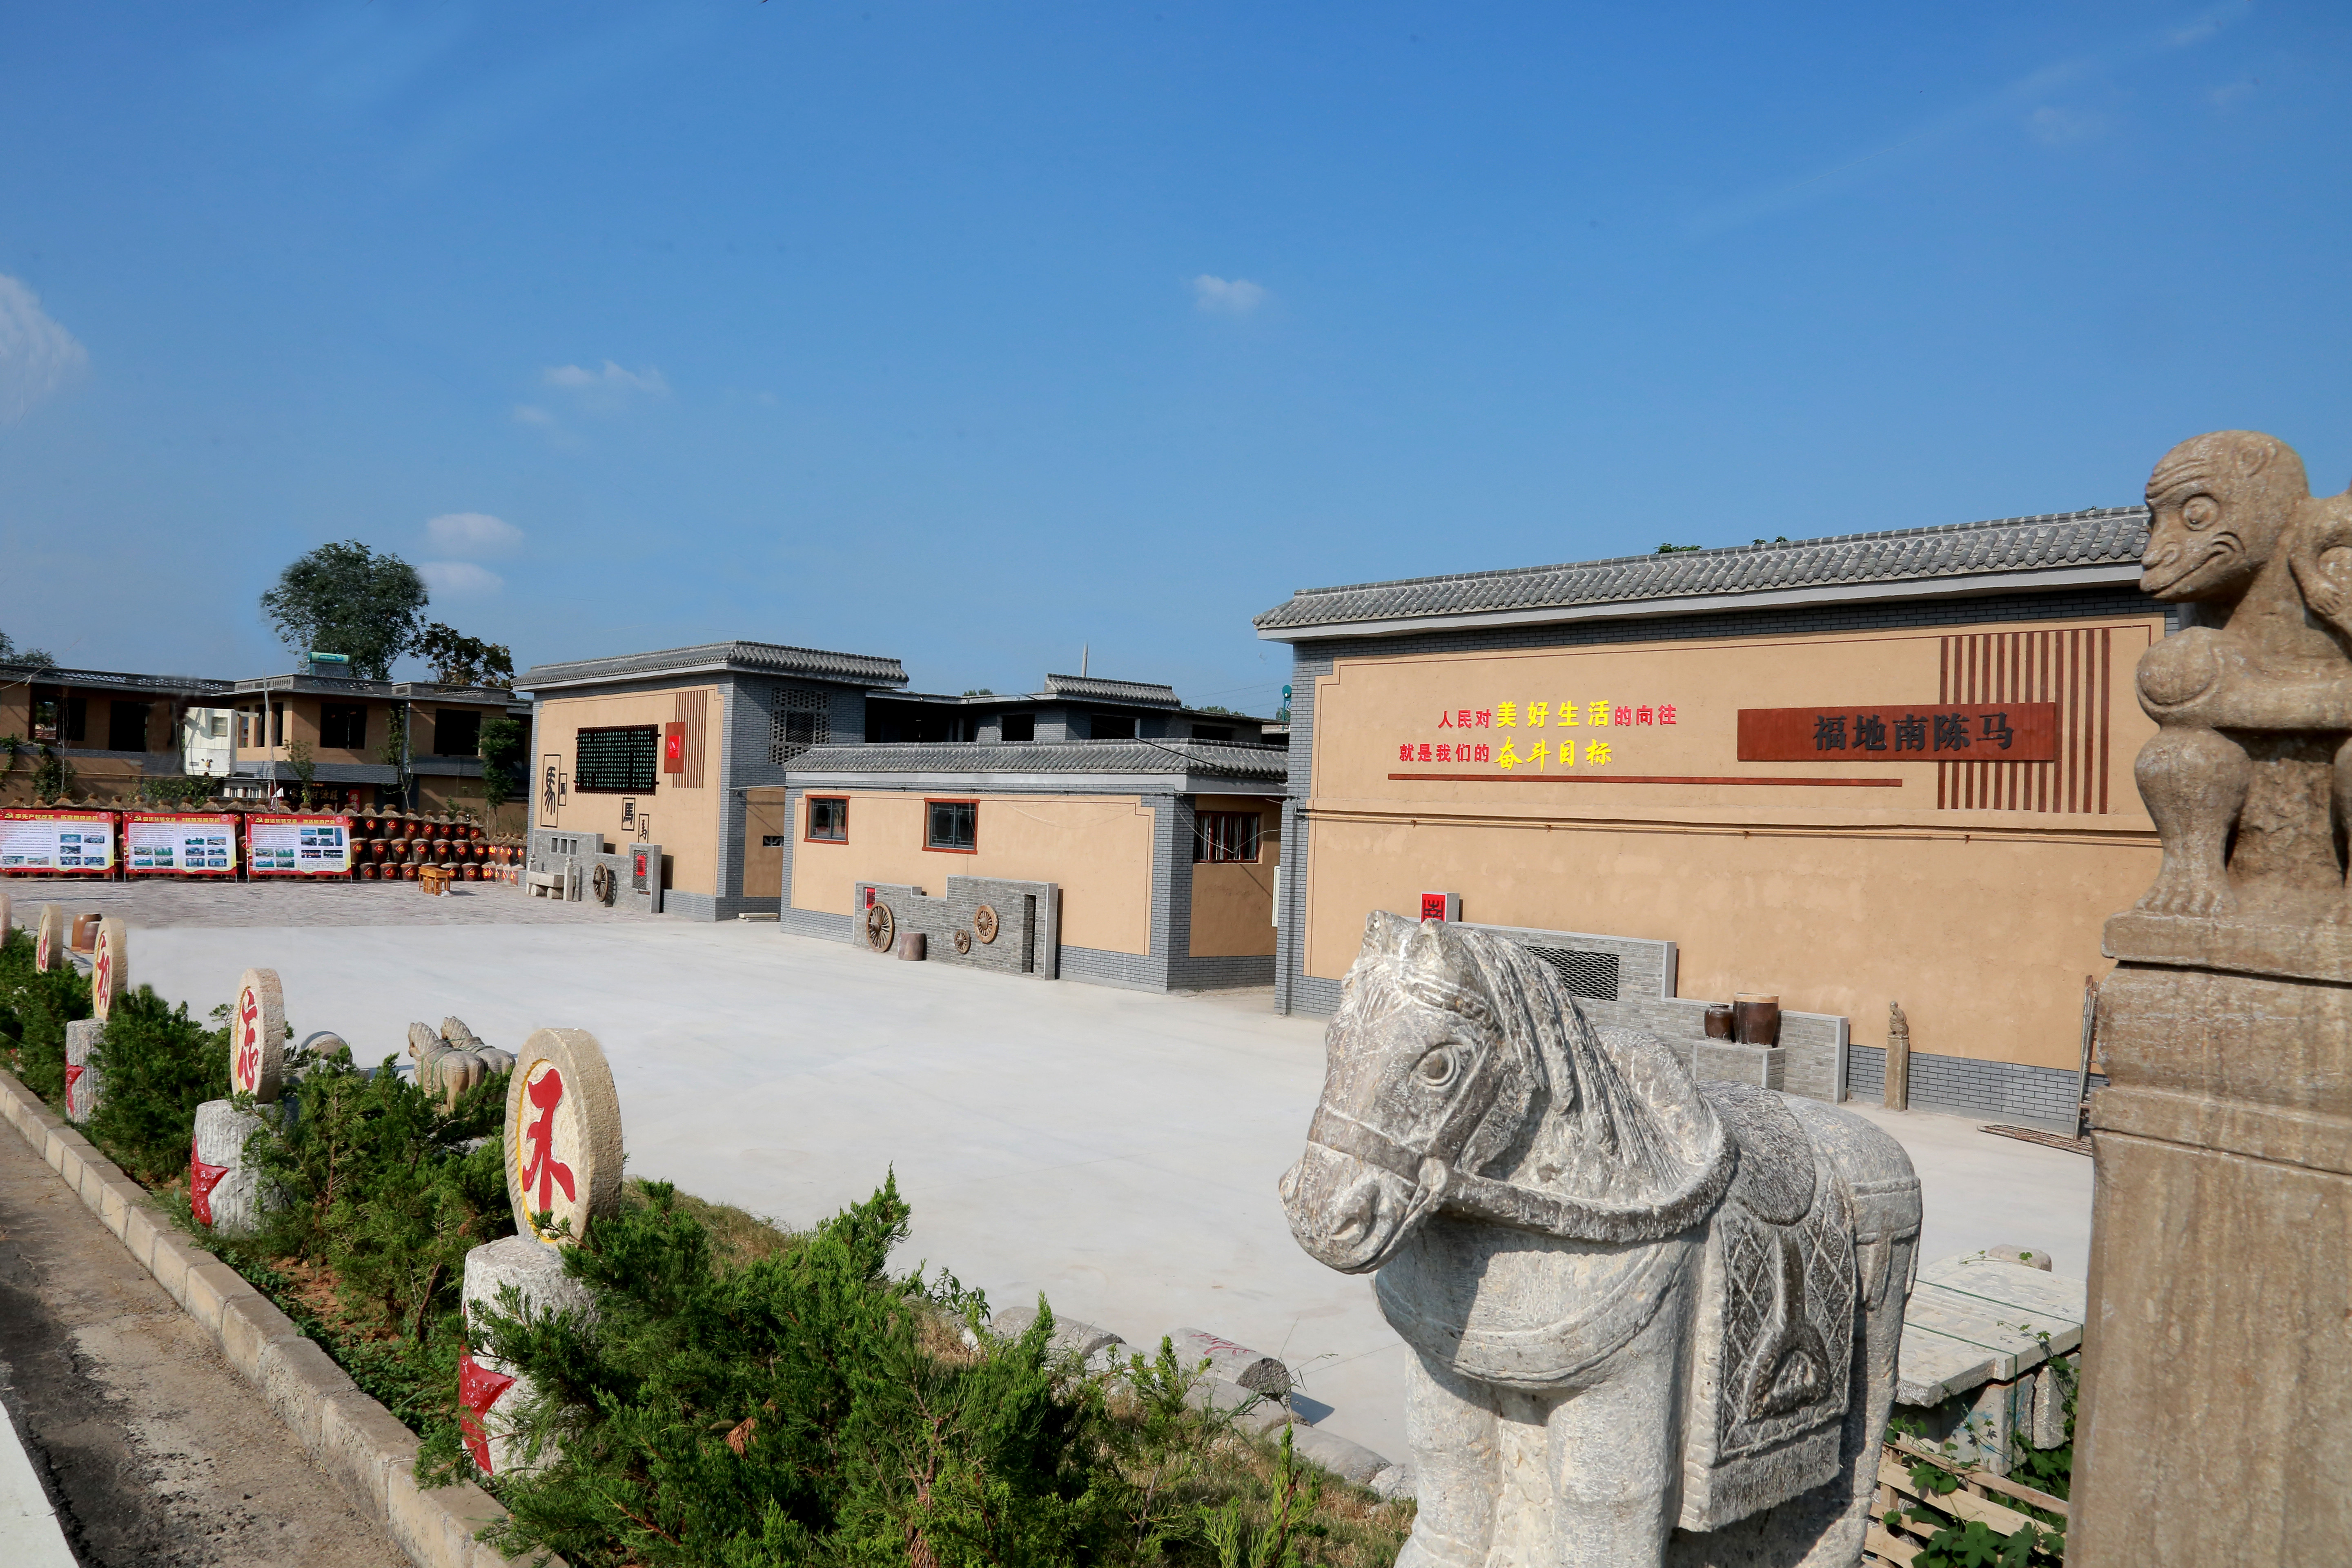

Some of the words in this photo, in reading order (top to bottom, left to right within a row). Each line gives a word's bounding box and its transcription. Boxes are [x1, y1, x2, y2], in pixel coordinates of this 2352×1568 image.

[1438, 699, 1677, 729] 人民对美好生活的向往
[1813, 712, 2014, 752] 福地南陈马
[1399, 735, 1613, 772] 就是我们的奋斗目标
[97, 935, 110, 1008] 初
[238, 989, 259, 1091] 忘
[522, 1068, 576, 1213] 不
